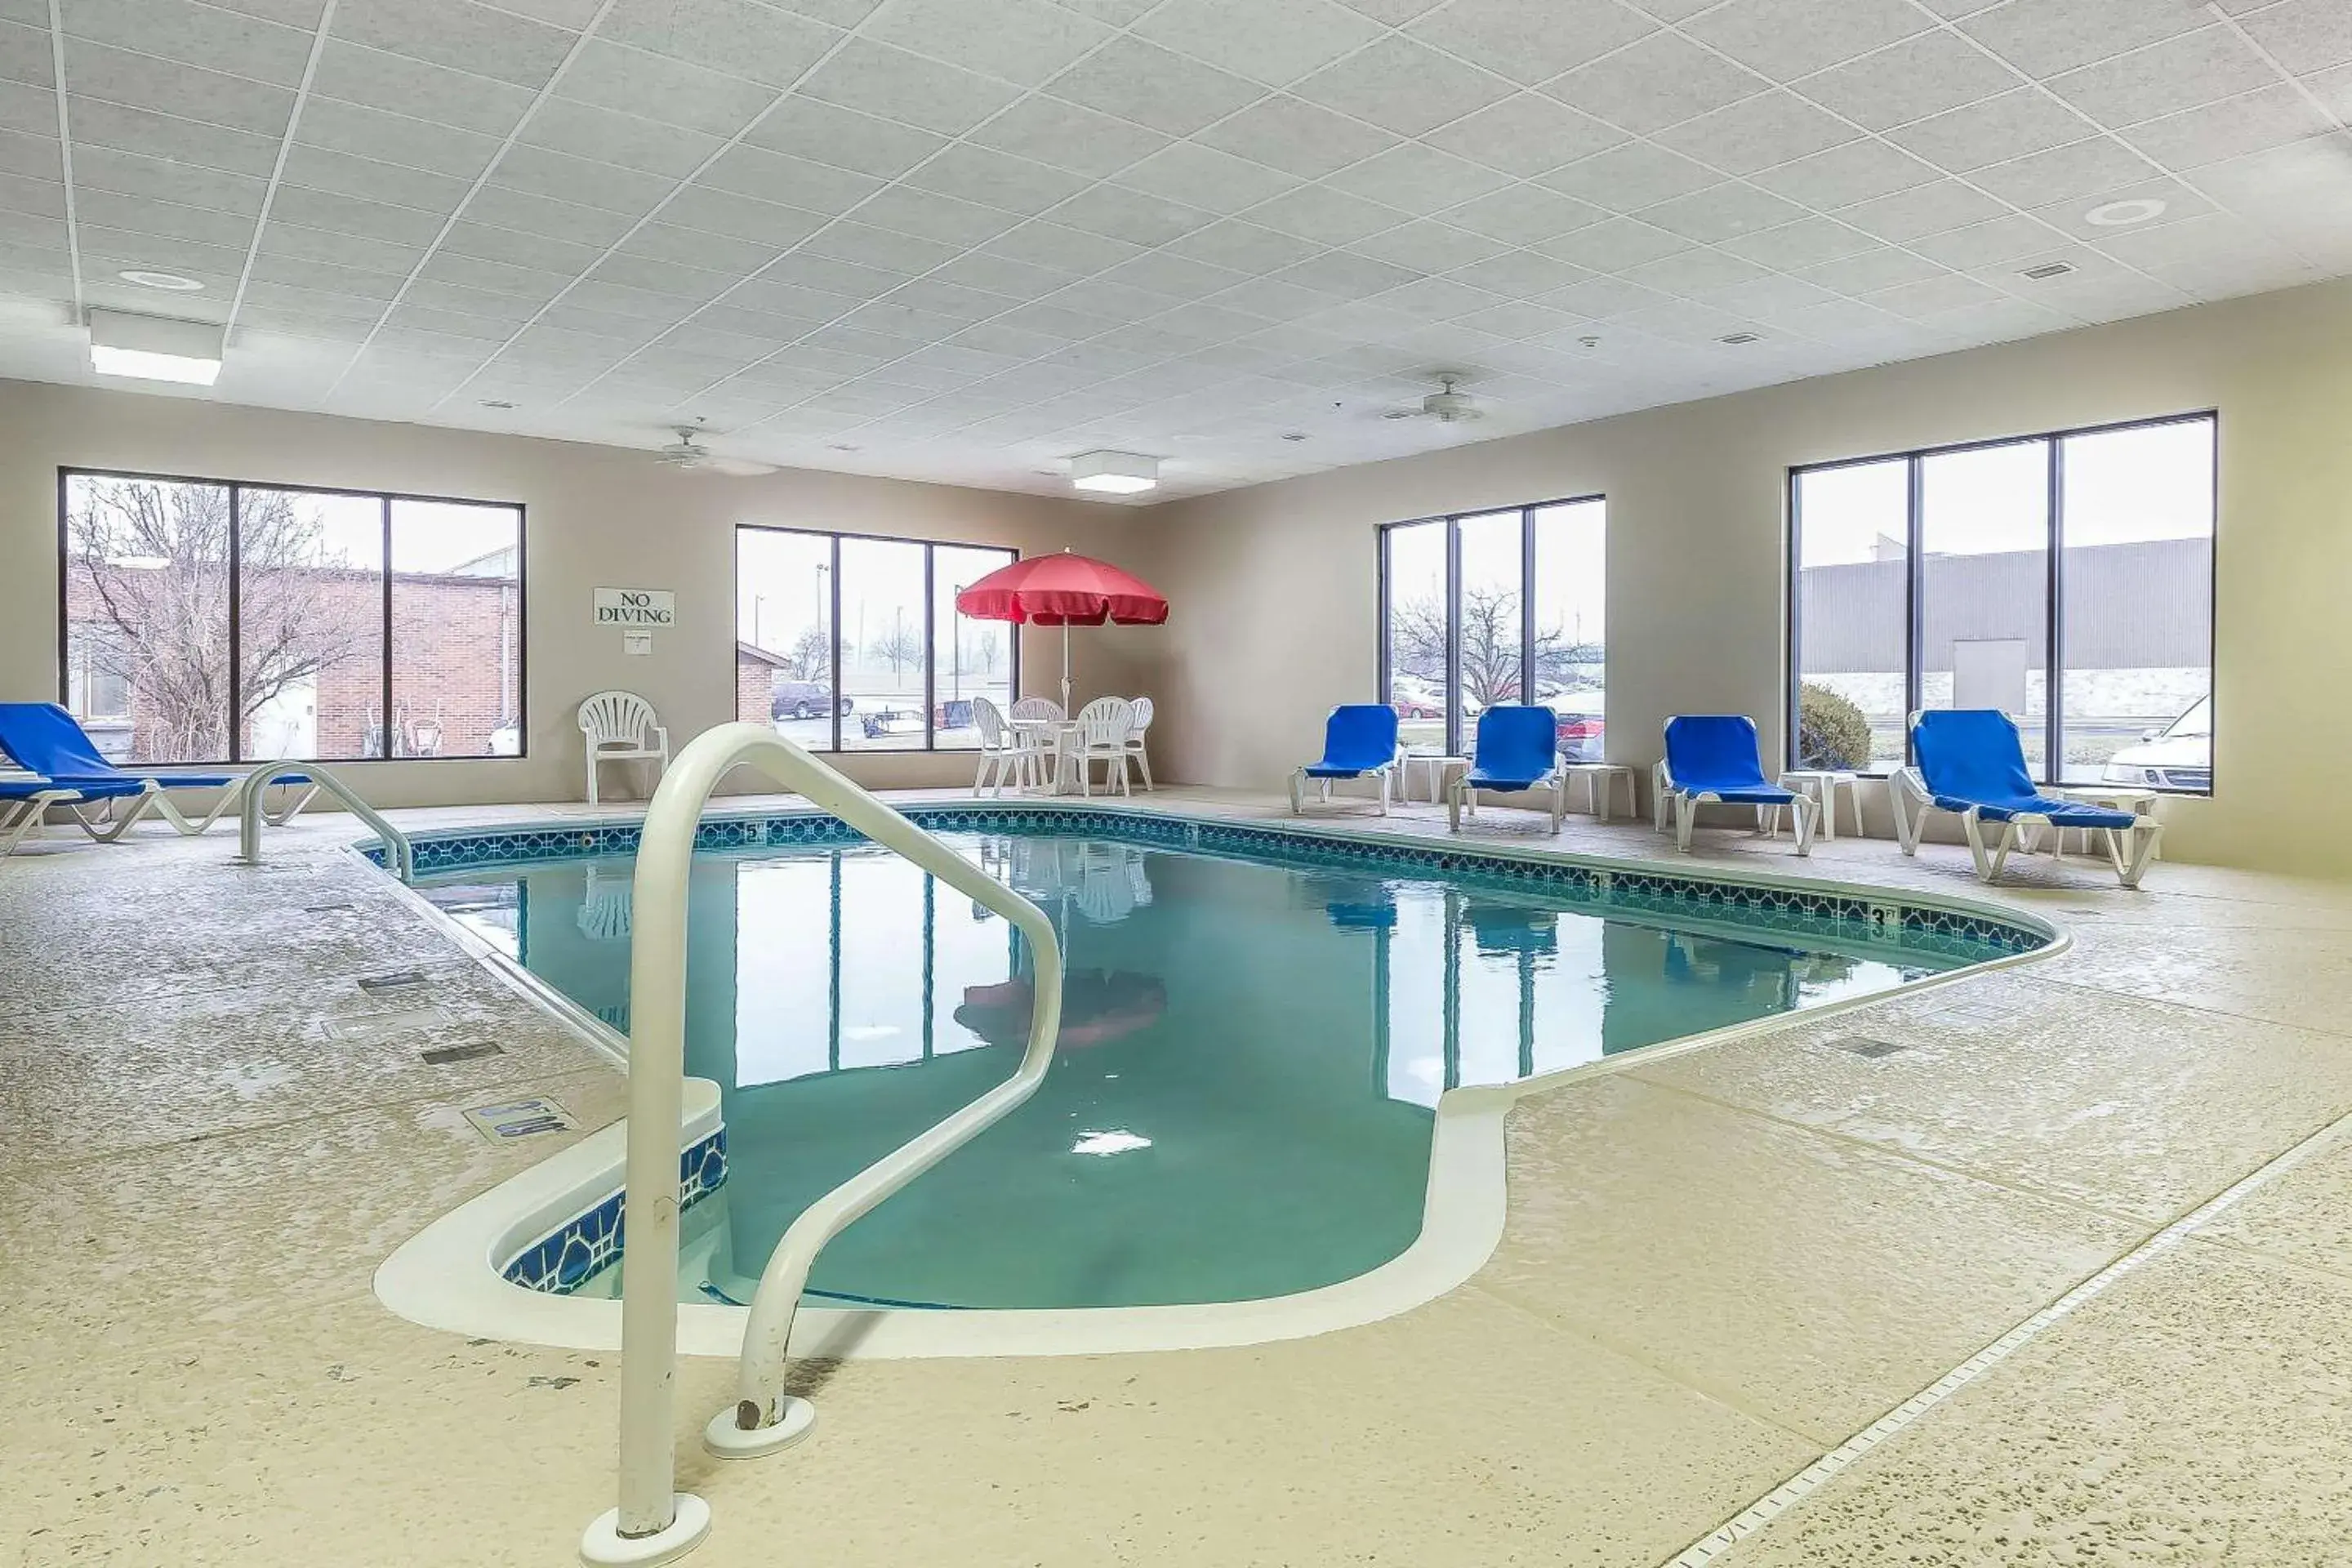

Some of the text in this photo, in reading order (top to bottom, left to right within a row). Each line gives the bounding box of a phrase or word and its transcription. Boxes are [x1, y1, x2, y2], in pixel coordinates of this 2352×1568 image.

[621, 592, 651, 607] NO
[599, 607, 670, 623] DIVING
[1872, 908, 1885, 926] 3
